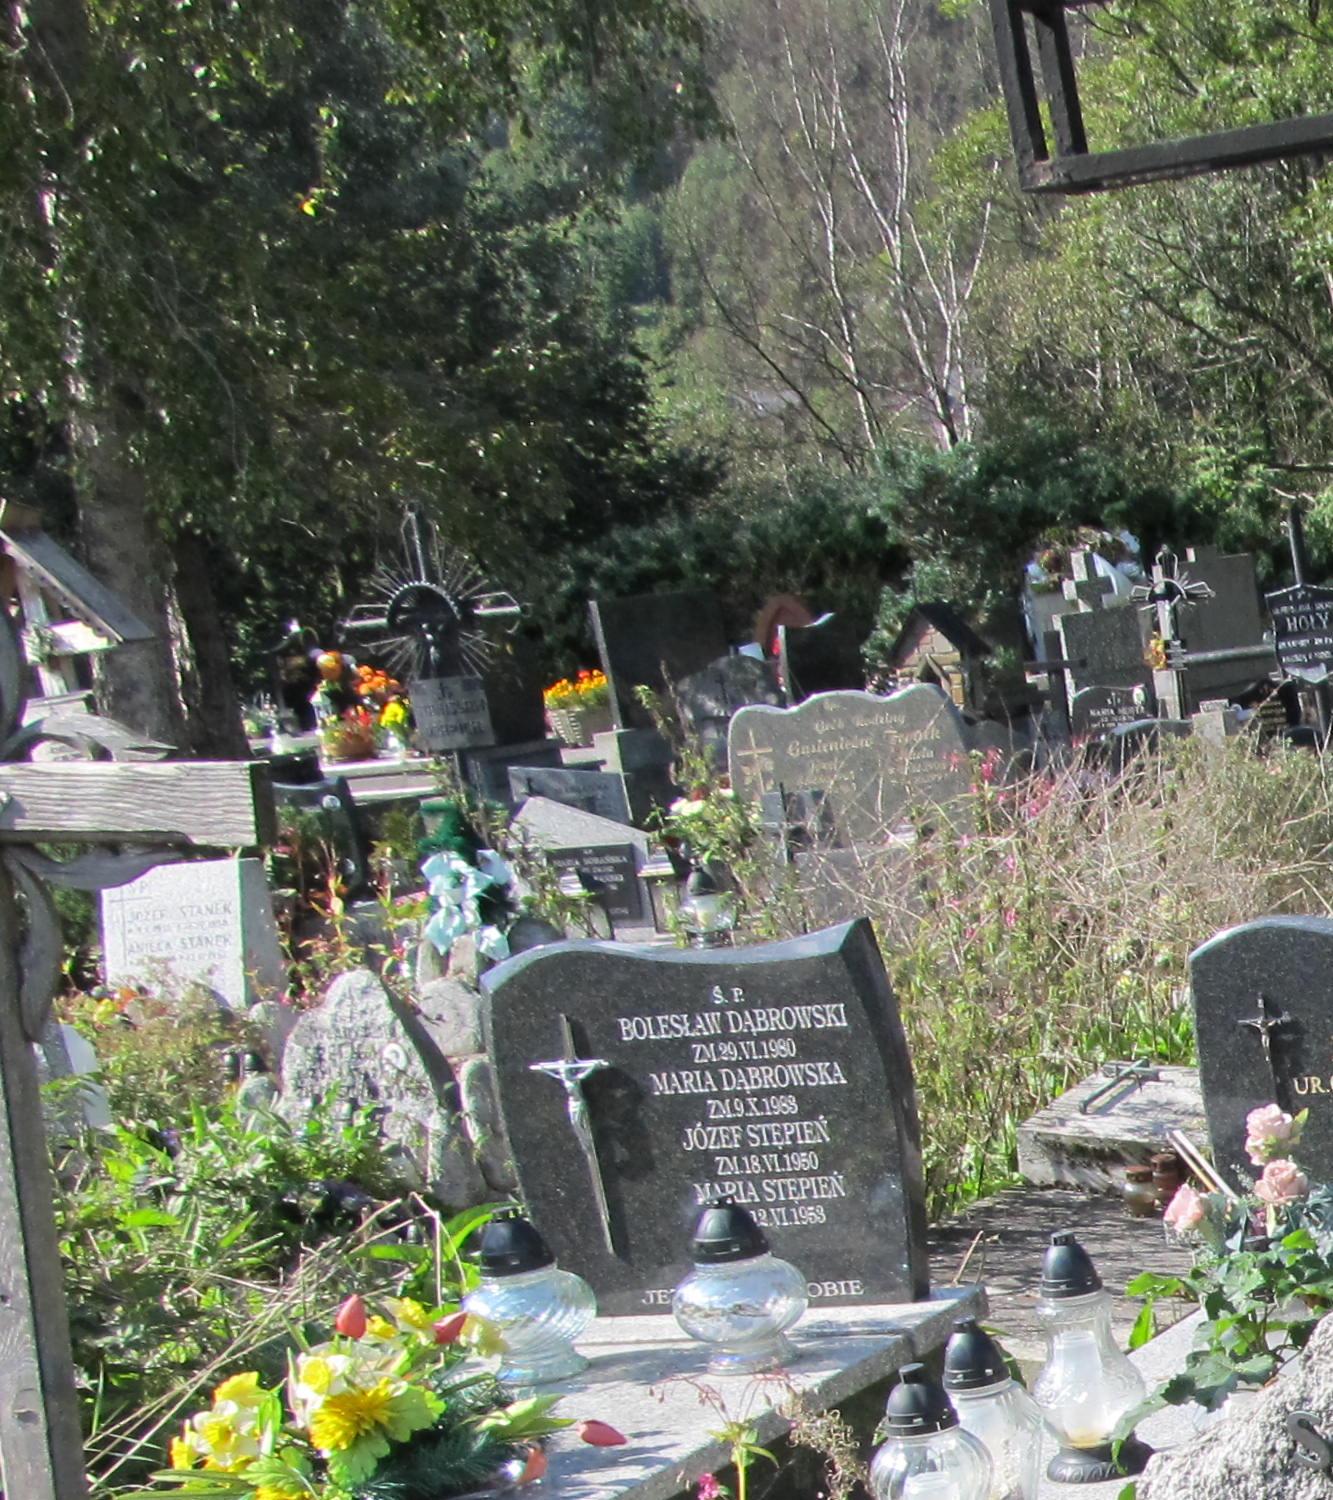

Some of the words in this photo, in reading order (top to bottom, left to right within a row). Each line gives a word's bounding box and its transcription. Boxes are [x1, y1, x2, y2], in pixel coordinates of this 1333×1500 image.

[180, 902, 232, 918] STANEK
[180, 935, 232, 951] STANEK
[617, 1011, 723, 1042] BOLESŁAW
[728, 1003, 849, 1037] DĄBROWSKI
[650, 1070, 719, 1096] MARIA
[722, 1062, 848, 1098] DĄBROWSKA
[683, 1121, 743, 1152] JÓZEF
[746, 1115, 831, 1150] STĘPIEŃ
[693, 1180, 761, 1205] MARIA
[762, 1171, 846, 1205] STĘPIEŃ
[750, 1204, 827, 1228] 12.VI.1953
[807, 1280, 865, 1298] OBIE
